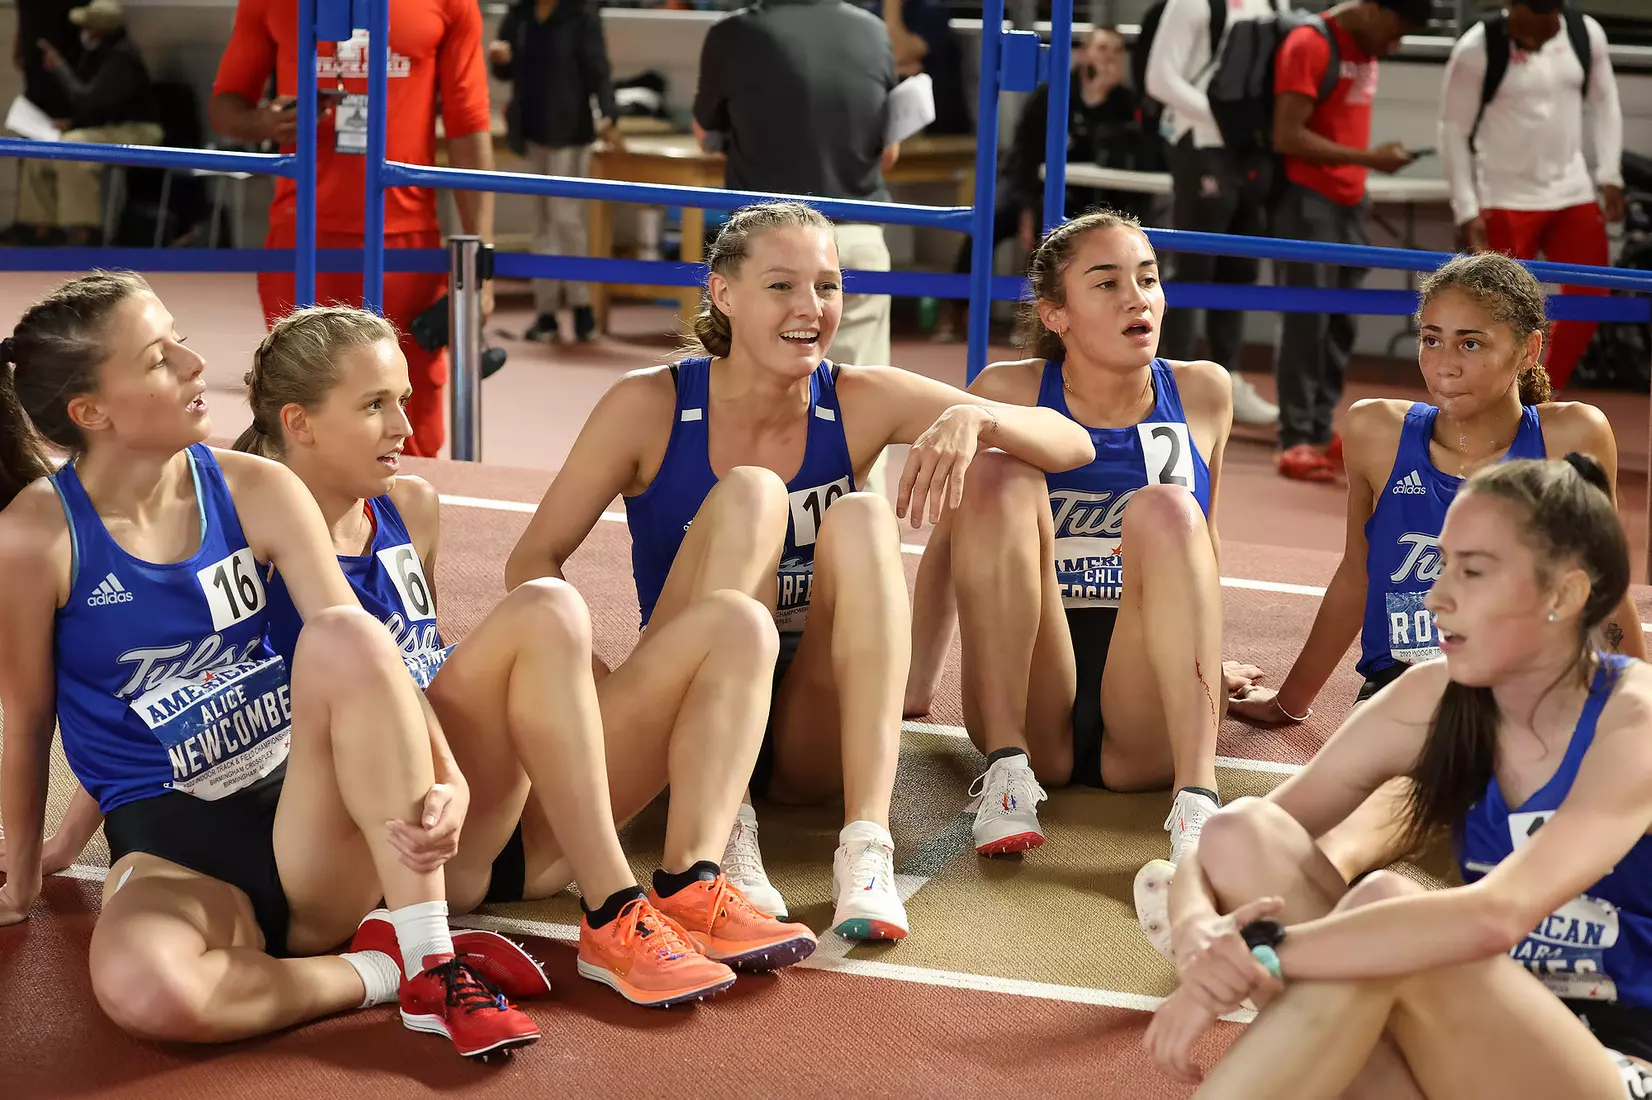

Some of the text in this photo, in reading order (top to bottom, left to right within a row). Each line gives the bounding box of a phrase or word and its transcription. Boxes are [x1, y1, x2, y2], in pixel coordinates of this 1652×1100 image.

[1151, 426, 1188, 486] 2
[1392, 484, 1427, 495] adidas
[1049, 488, 1138, 538] Tul
[1390, 532, 1443, 583] Tu
[87, 591, 134, 606] adidas
[213, 555, 258, 620] 16
[396, 548, 429, 616] 6
[776, 606, 810, 617] CHAMPIONSH
[201, 684, 247, 725] ALICE
[168, 684, 291, 779] NEWCOMBE
[195, 769, 217, 783] INDOOR
[216, 760, 234, 773] TRACK
[240, 750, 255, 762] FIELD
[209, 749, 274, 786] BIRMINGHAM CROSSPLEX
